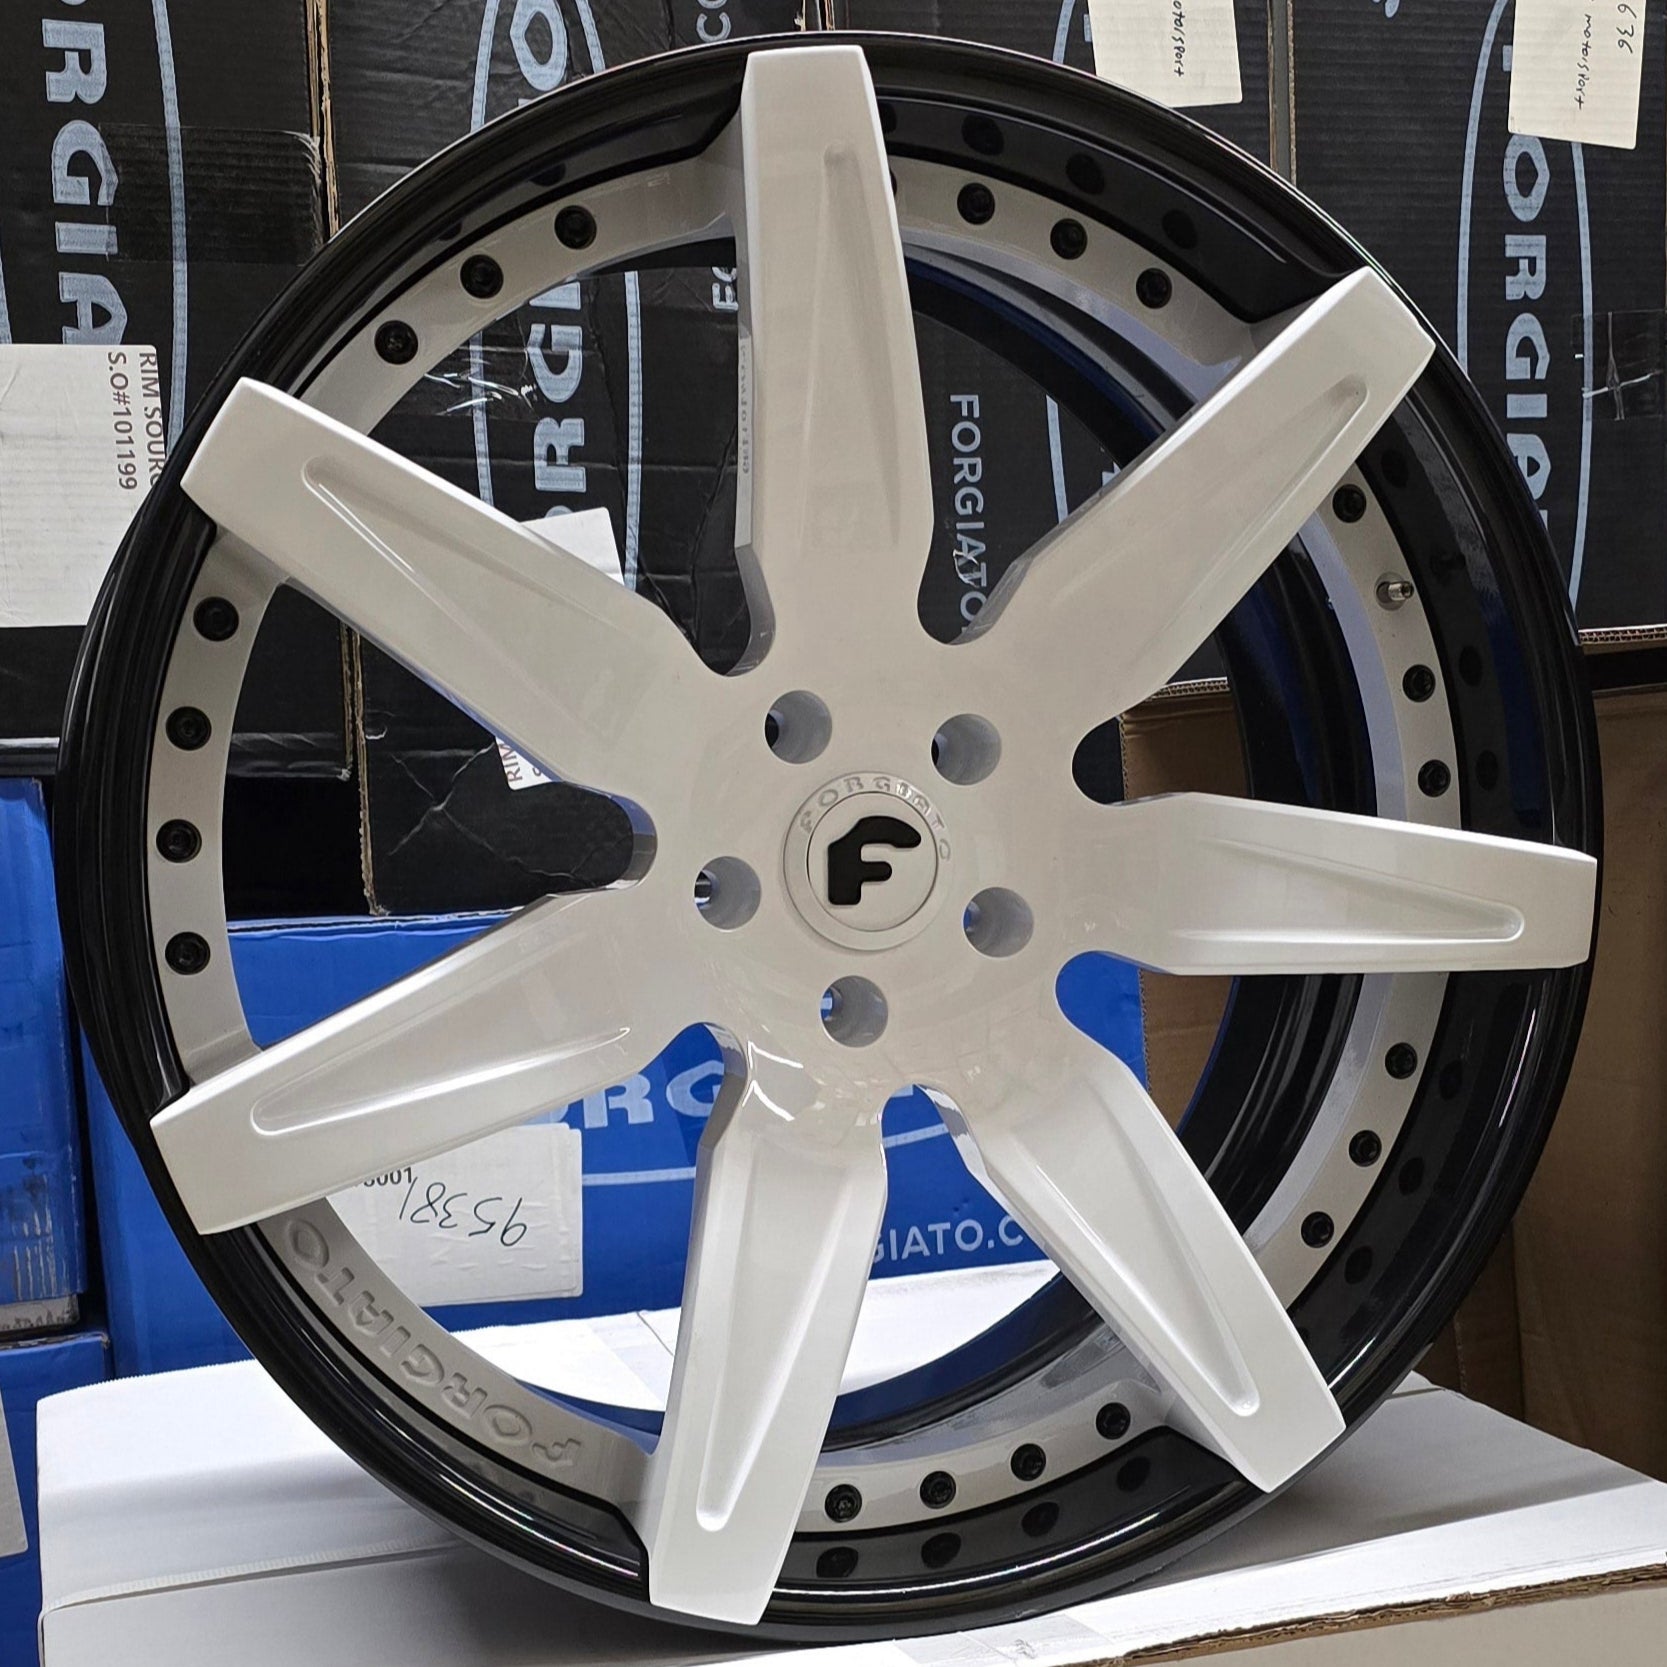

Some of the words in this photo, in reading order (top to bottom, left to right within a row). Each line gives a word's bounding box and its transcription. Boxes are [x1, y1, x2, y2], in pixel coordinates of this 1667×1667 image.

[108, 351, 138, 490] S.O#101199
[139, 352, 160, 398] RIM
[800, 776, 951, 862] FORGIATO
[283, 1216, 582, 1468] FORGIATO
